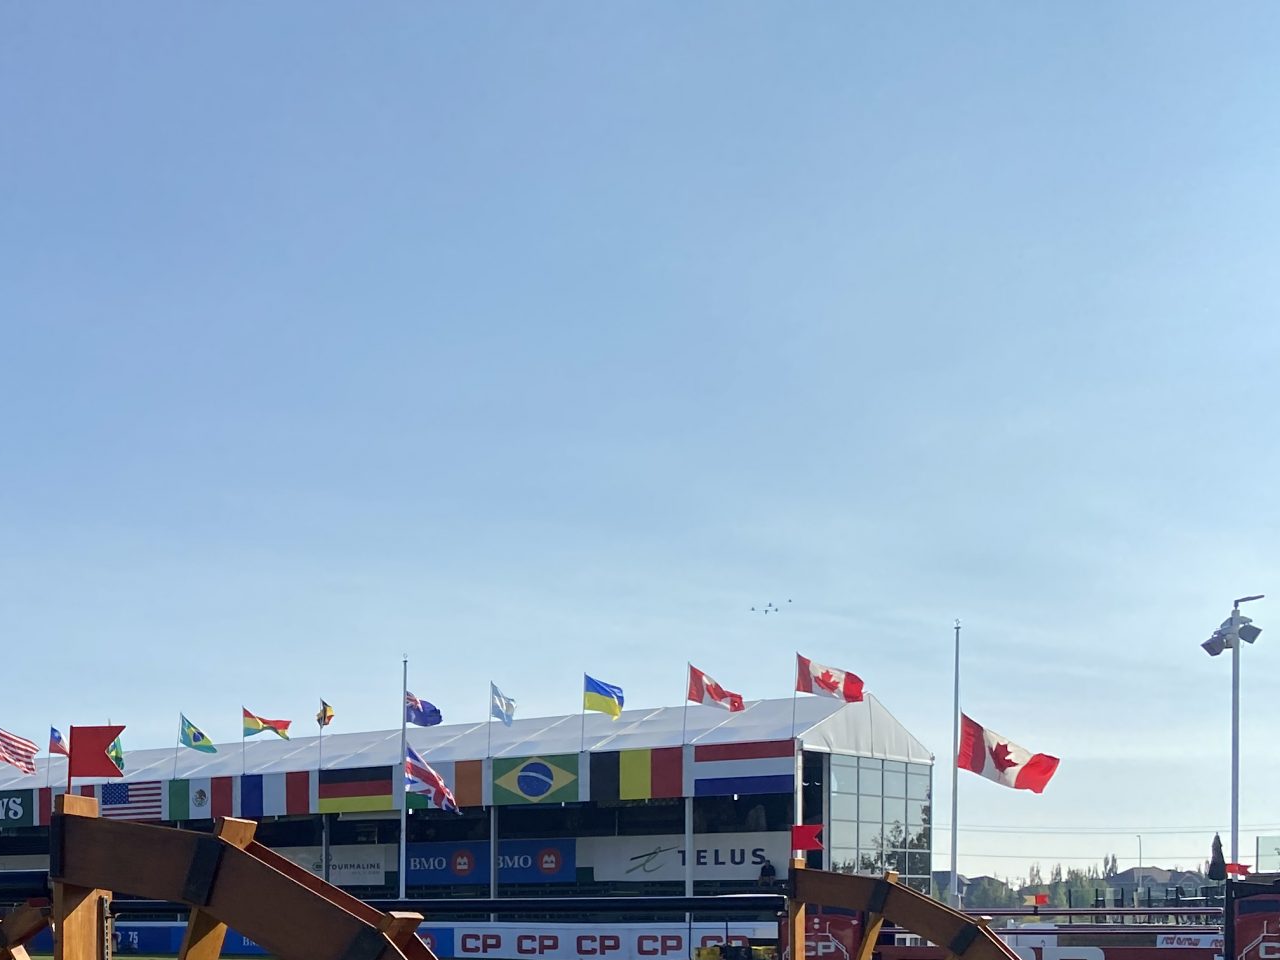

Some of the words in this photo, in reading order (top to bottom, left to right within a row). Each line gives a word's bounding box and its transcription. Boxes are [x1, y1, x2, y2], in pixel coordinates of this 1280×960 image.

[409, 857, 447, 870] BMO
[677, 848, 766, 866] TELUS
[128, 931, 139, 943] 75
[461, 934, 502, 954] CP
[516, 935, 559, 955] CP
[576, 935, 620, 956] CP
[637, 935, 683, 956] CP
